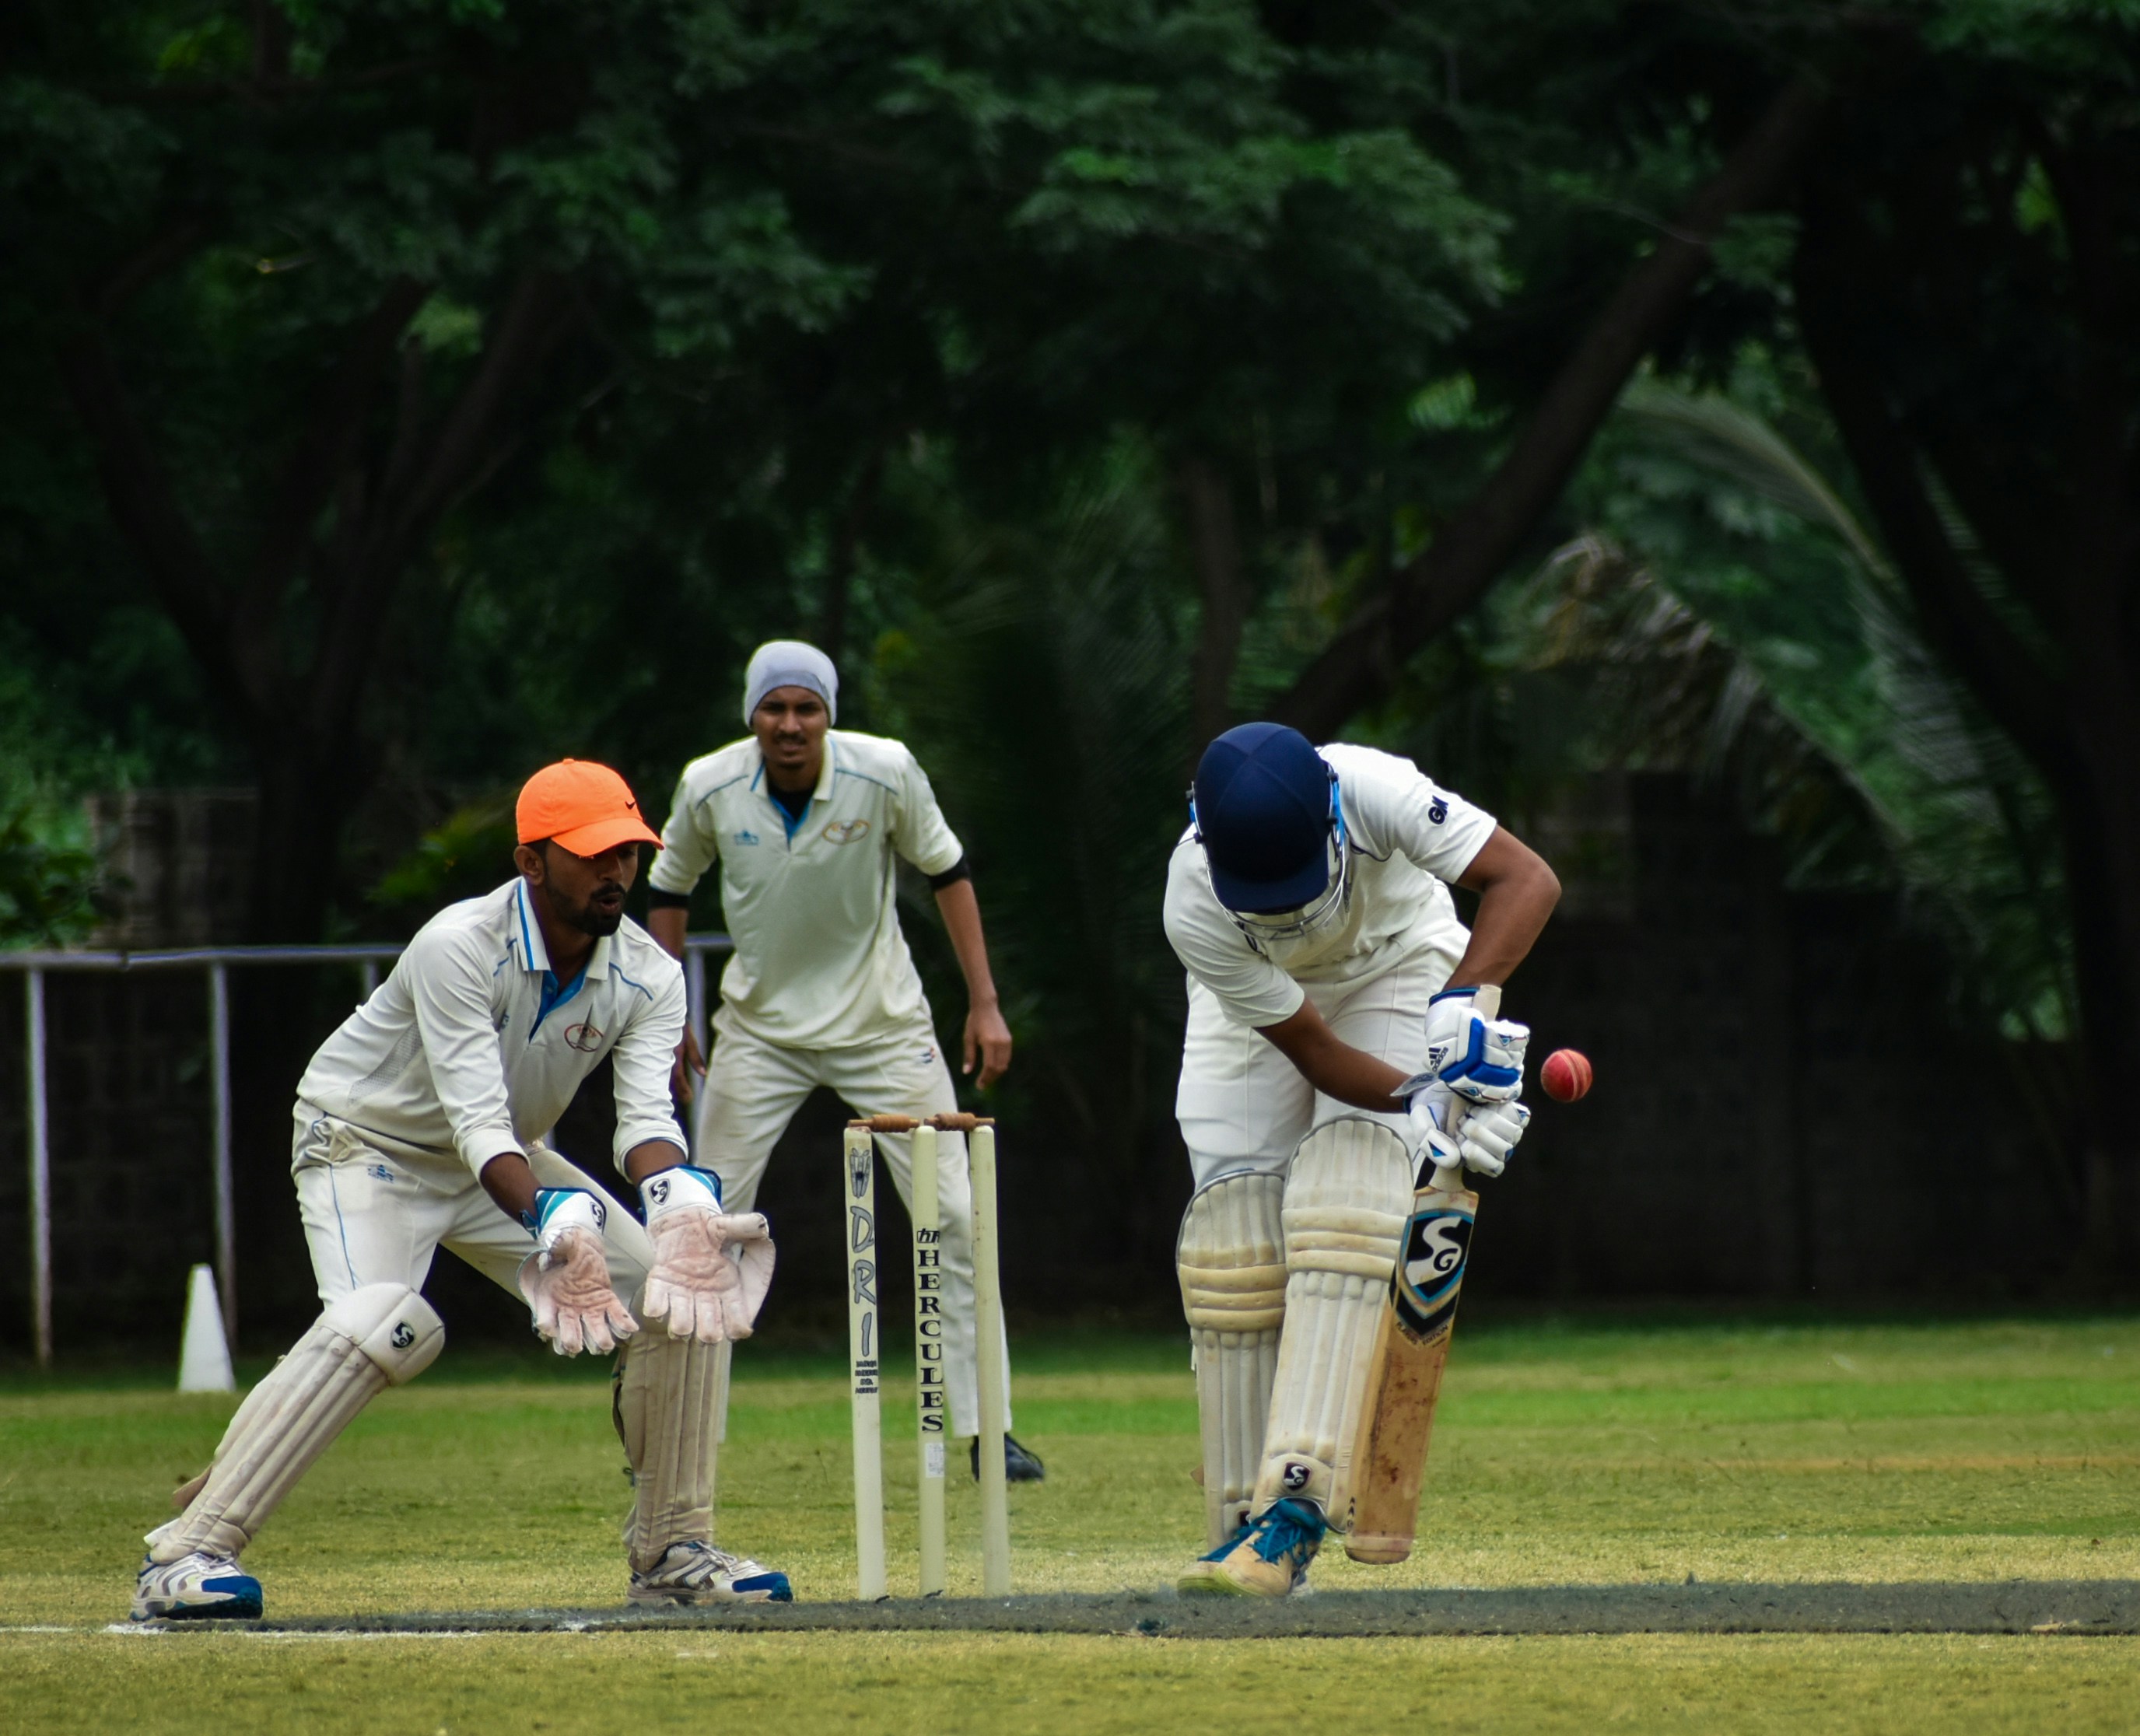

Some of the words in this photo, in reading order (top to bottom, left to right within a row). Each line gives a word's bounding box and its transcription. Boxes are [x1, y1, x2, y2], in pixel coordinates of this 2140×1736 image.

[1428, 795, 1448, 824] GM
[1432, 1047, 1448, 1072] adidas
[651, 1180, 669, 1204] SG
[1406, 1216, 1462, 1286] SG
[391, 1325, 414, 1347] SG
[917, 1250, 943, 1431] HERCULES
[1422, 1325, 1448, 1346] EDITION
[1284, 1465, 1306, 1486] SG
